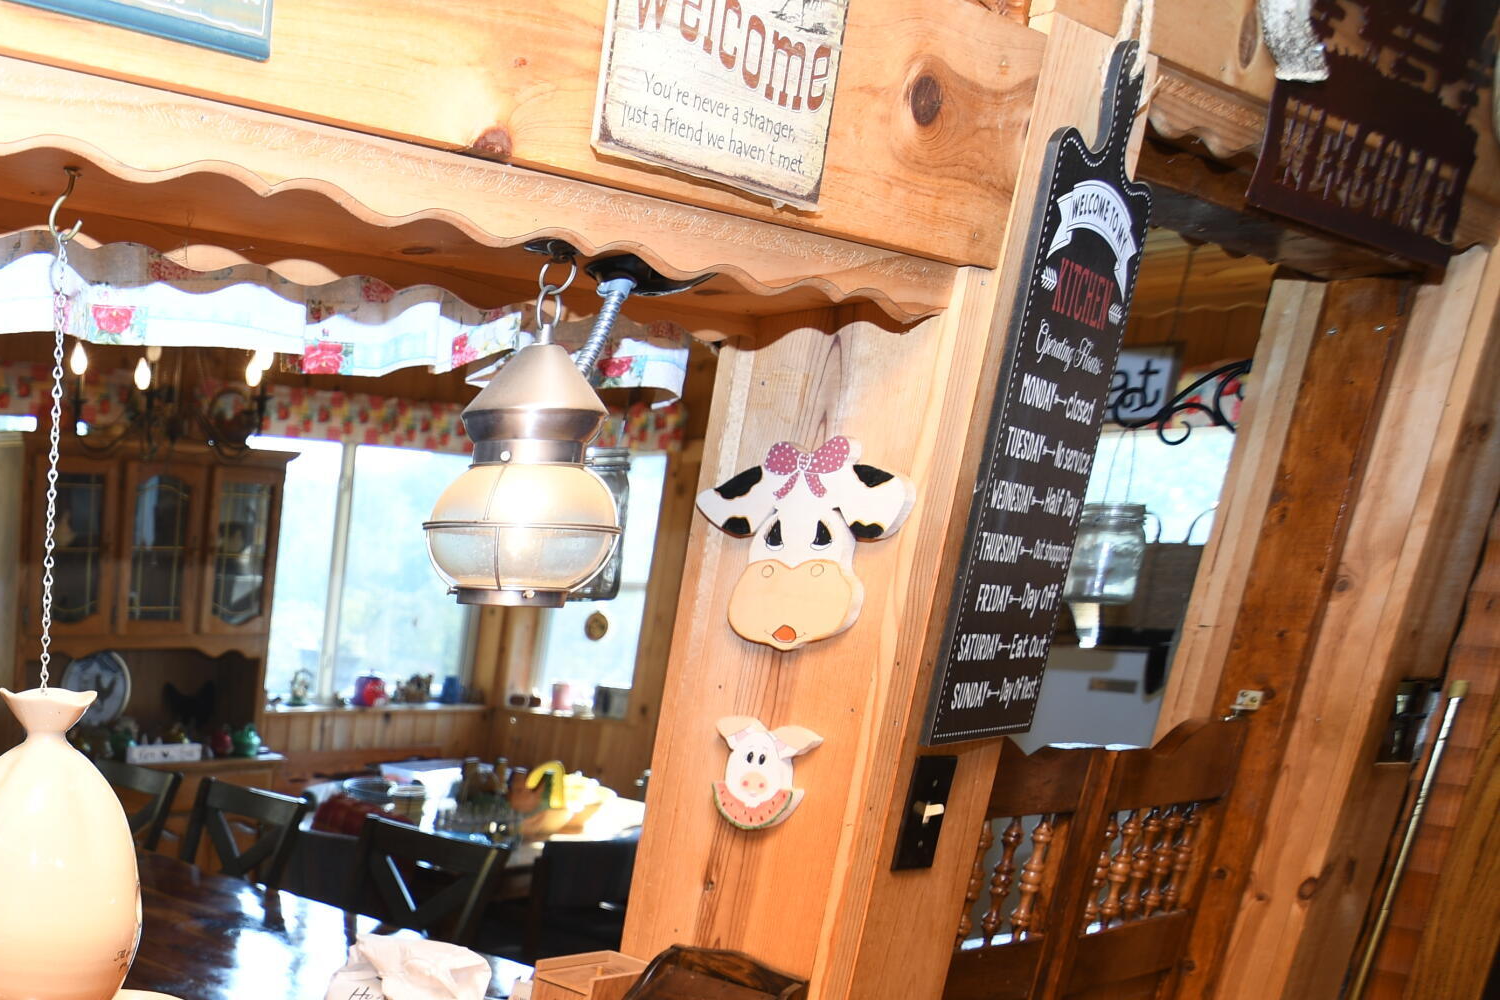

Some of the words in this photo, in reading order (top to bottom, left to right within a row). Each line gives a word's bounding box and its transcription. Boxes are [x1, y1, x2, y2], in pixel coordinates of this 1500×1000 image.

[644, 71, 690, 106] You're
[693, 94, 730, 119] never
[731, 107, 740, 122] a
[742, 110, 797, 142] stranger,
[621, 101, 648, 127] just
[651, 112, 660, 130] a
[662, 108, 703, 145] friend
[706, 130, 726, 151] we
[728, 134, 775, 166] haven't
[777, 151, 806, 176] met.
[1072, 193, 1110, 222] WELCOME
[1109, 209, 1119, 229] TO
[1117, 222, 1129, 250] MY
[1052, 257, 1115, 331] KITCHEN
[1035, 318, 1074, 372] Operating
[1019, 373, 1057, 413] MONDAY
[1065, 391, 1095, 425] closed
[1005, 427, 1045, 463] TUESDAY
[1054, 440, 1063, 469] No
[1062, 448, 1090, 475] service
[990, 480, 1035, 513] WEDNESDAY
[1043, 487, 1063, 515] Half
[1062, 491, 1079, 526] Day
[979, 532, 1023, 564] THURSDAY
[1033, 539, 1045, 560] Out
[975, 584, 1011, 613] FRIDAY
[1021, 583, 1038, 618] Day
[1039, 583, 1059, 611] Off
[957, 634, 1000, 662] SATURDAY
[1009, 635, 1027, 658] Eat
[1028, 635, 1047, 658] Out
[951, 681, 989, 711] SUNDAY
[999, 678, 1012, 709] Day
[1012, 677, 1021, 701] Of
[1020, 676, 1039, 700] Rest
